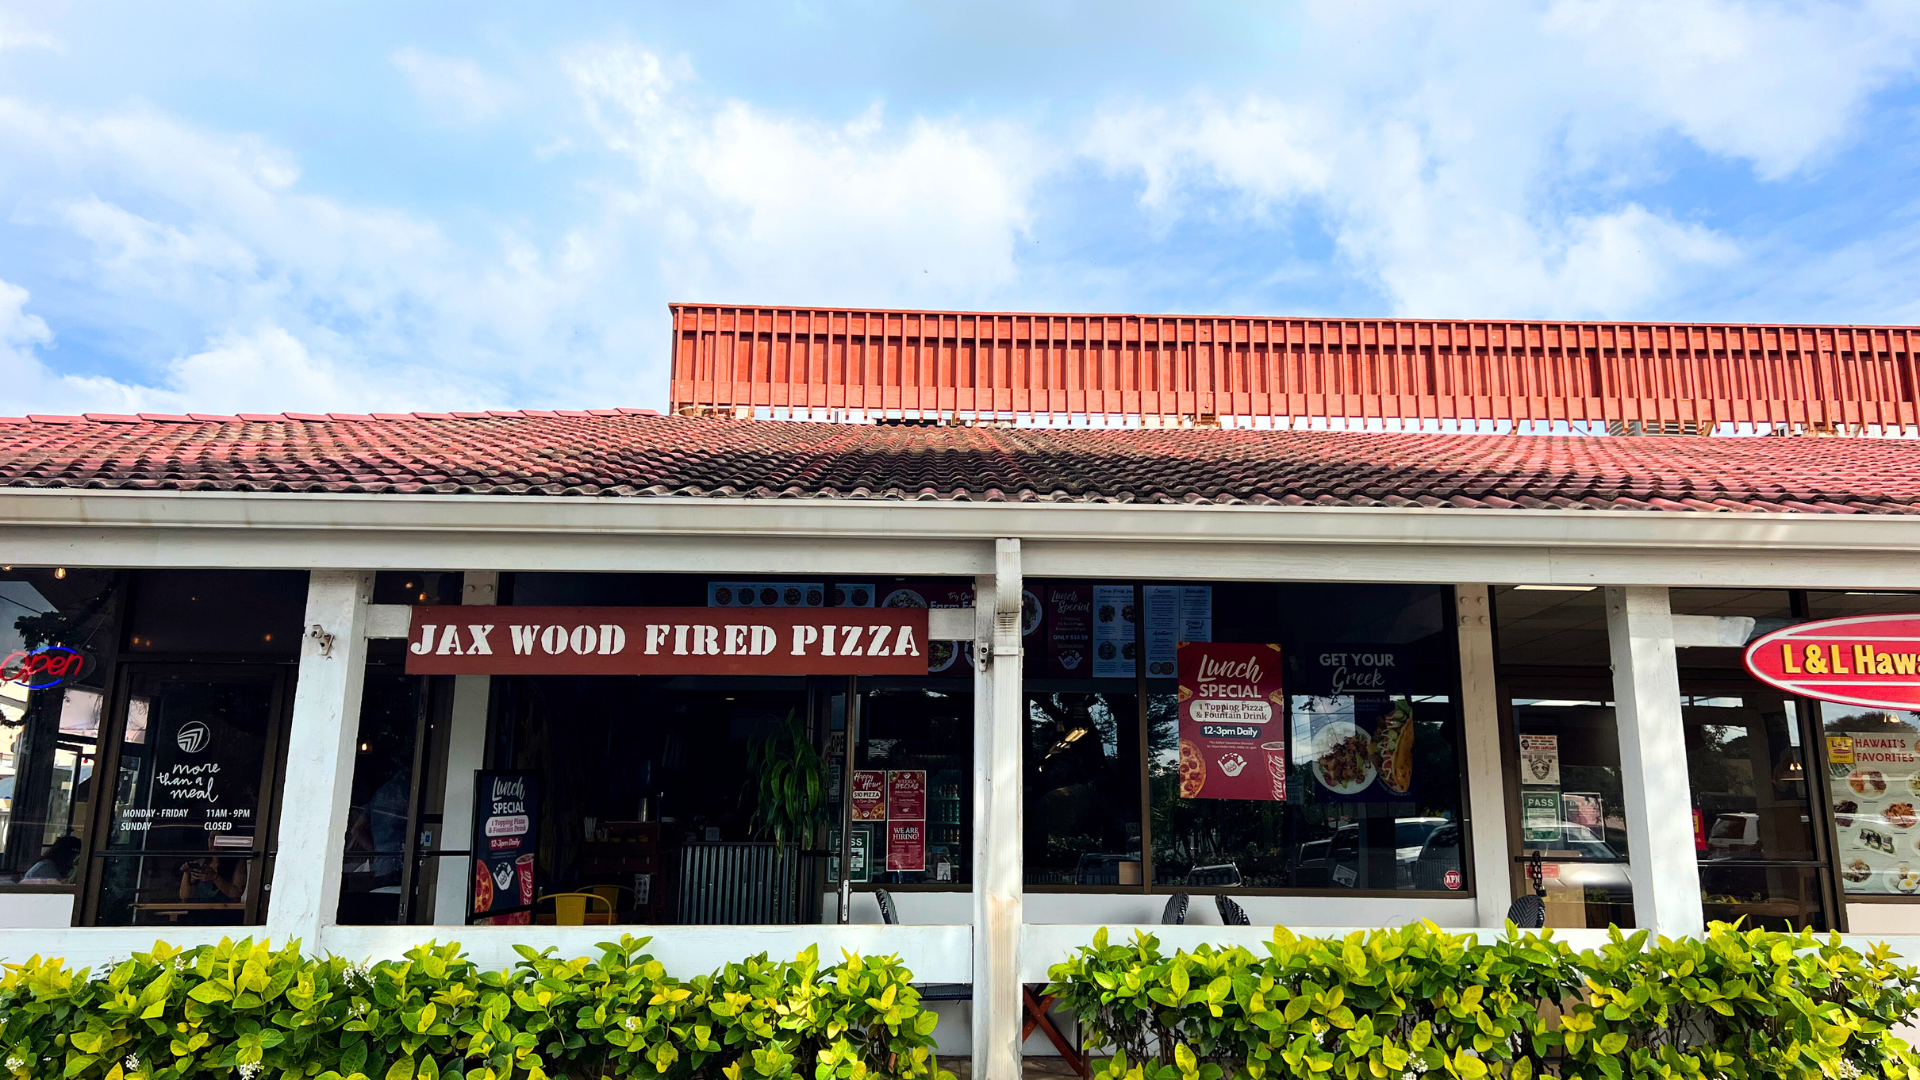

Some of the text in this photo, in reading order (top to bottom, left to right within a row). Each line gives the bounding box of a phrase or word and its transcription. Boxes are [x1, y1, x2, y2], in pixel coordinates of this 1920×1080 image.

[1051, 590, 1078, 602] Lunch
[1058, 601, 1090, 614] Special
[410, 624, 920, 656] JAX WOOD FIRED PIZZA
[1319, 653, 1395, 666] GET YOUR
[1853, 644, 1920, 675] Haw
[0, 651, 84, 683] Open
[1197, 654, 1263, 684] Lunch
[1331, 666, 1385, 695] Greek
[1199, 684, 1262, 698] SPECIAL
[1204, 703, 1240, 713] Topping
[1241, 703, 1263, 711] Pizza
[1204, 711, 1242, 719] Fountain
[1243, 712, 1267, 720] Drink
[1203, 725, 1258, 738] 12-3pm Daily
[1855, 739, 1906, 748] HAWAII'S
[1856, 752, 1915, 763] FAVORITES
[172, 763, 220, 775] more
[156, 772, 203, 786] than a
[854, 772, 875, 783] Happy
[170, 777, 219, 803] meal
[492, 776, 526, 802] Lunch
[862, 780, 881, 790] Hour
[492, 801, 526, 815] SPECIAL
[1528, 798, 1554, 807] PASS
[122, 809, 155, 818] MONDAY
[161, 809, 189, 818] FRIDAY
[206, 809, 228, 818] 11AM
[233, 809, 250, 818] 9PM
[121, 822, 232, 831] SUNDAY CLOSED
[508, 837, 521, 847] Daily
[835, 837, 863, 847] PSS
